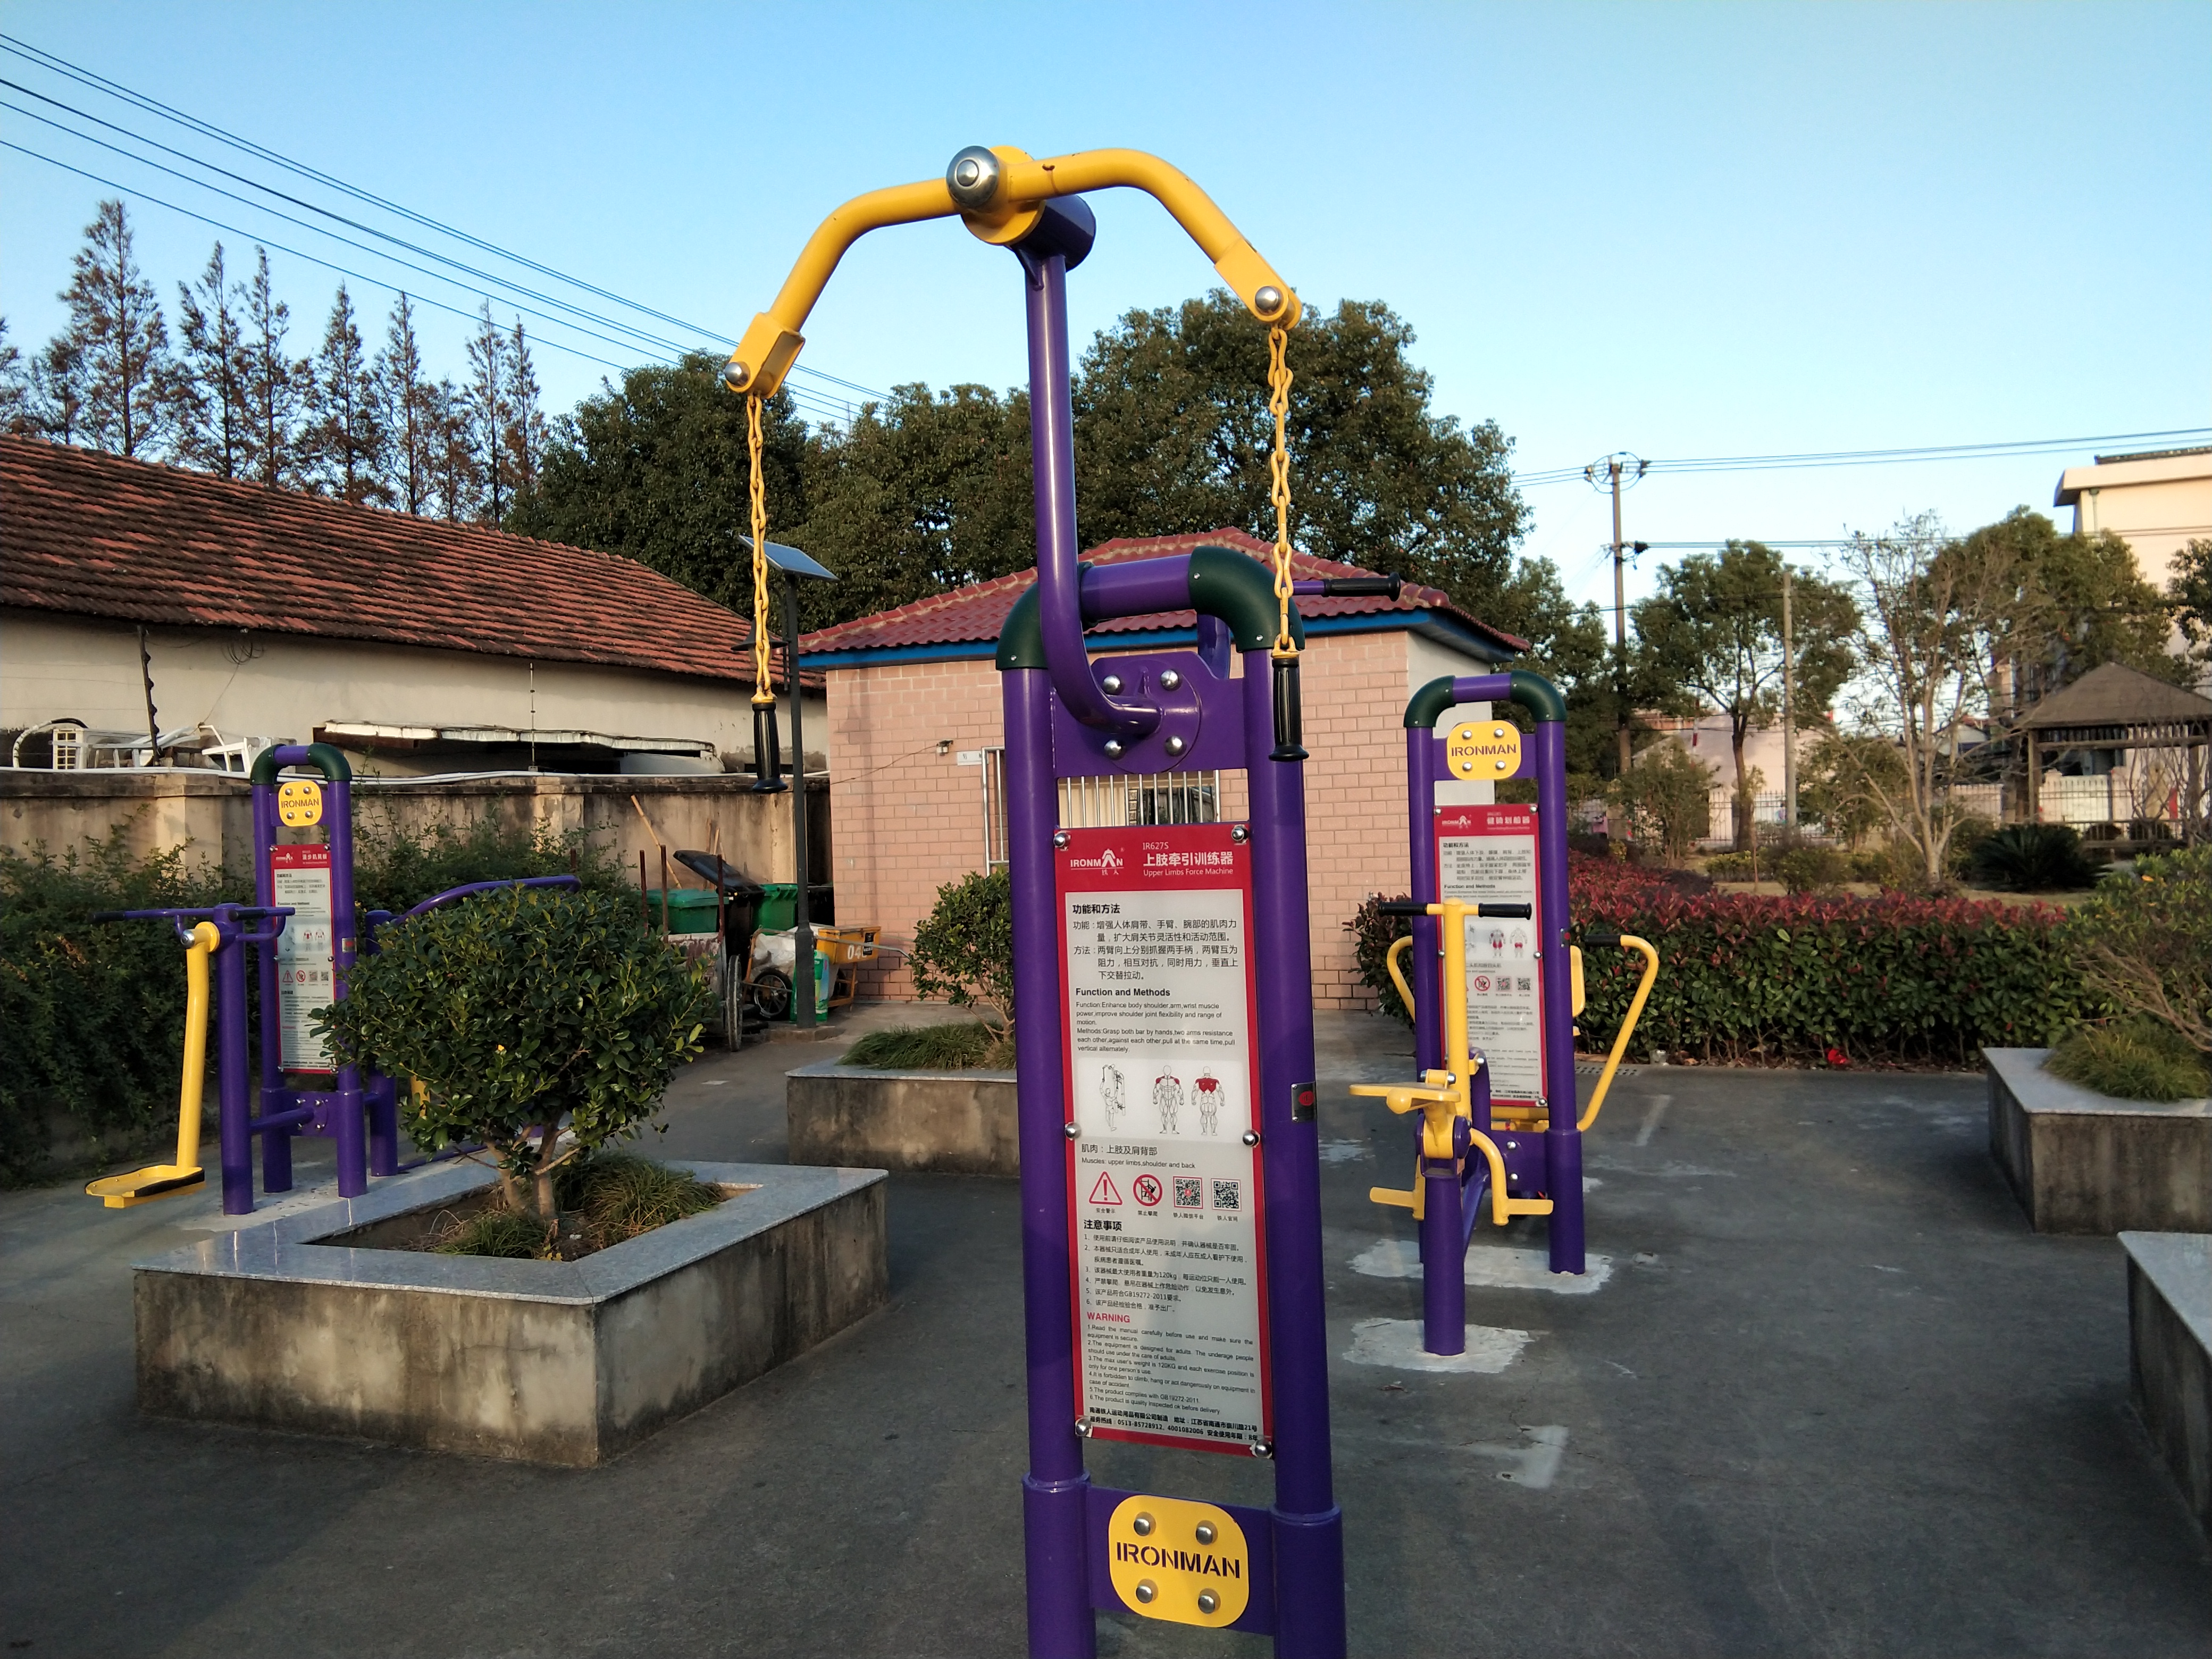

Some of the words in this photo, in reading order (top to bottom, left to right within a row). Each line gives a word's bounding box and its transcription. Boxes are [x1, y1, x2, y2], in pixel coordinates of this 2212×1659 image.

[1452, 744, 1516, 757] IRONMAN
[281, 798, 319, 808] IRONMAN
[1070, 849, 1123, 867] IRONMAN
[1144, 851, 1233, 866] 上肢牵引训练器
[1073, 904, 1120, 914] 功能和方法
[848, 944, 867, 959] 04
[1084, 1219, 1122, 1231] 注意事项
[1087, 1312, 1130, 1323] WARNING
[1117, 1542, 1240, 1578] IRONMAN
